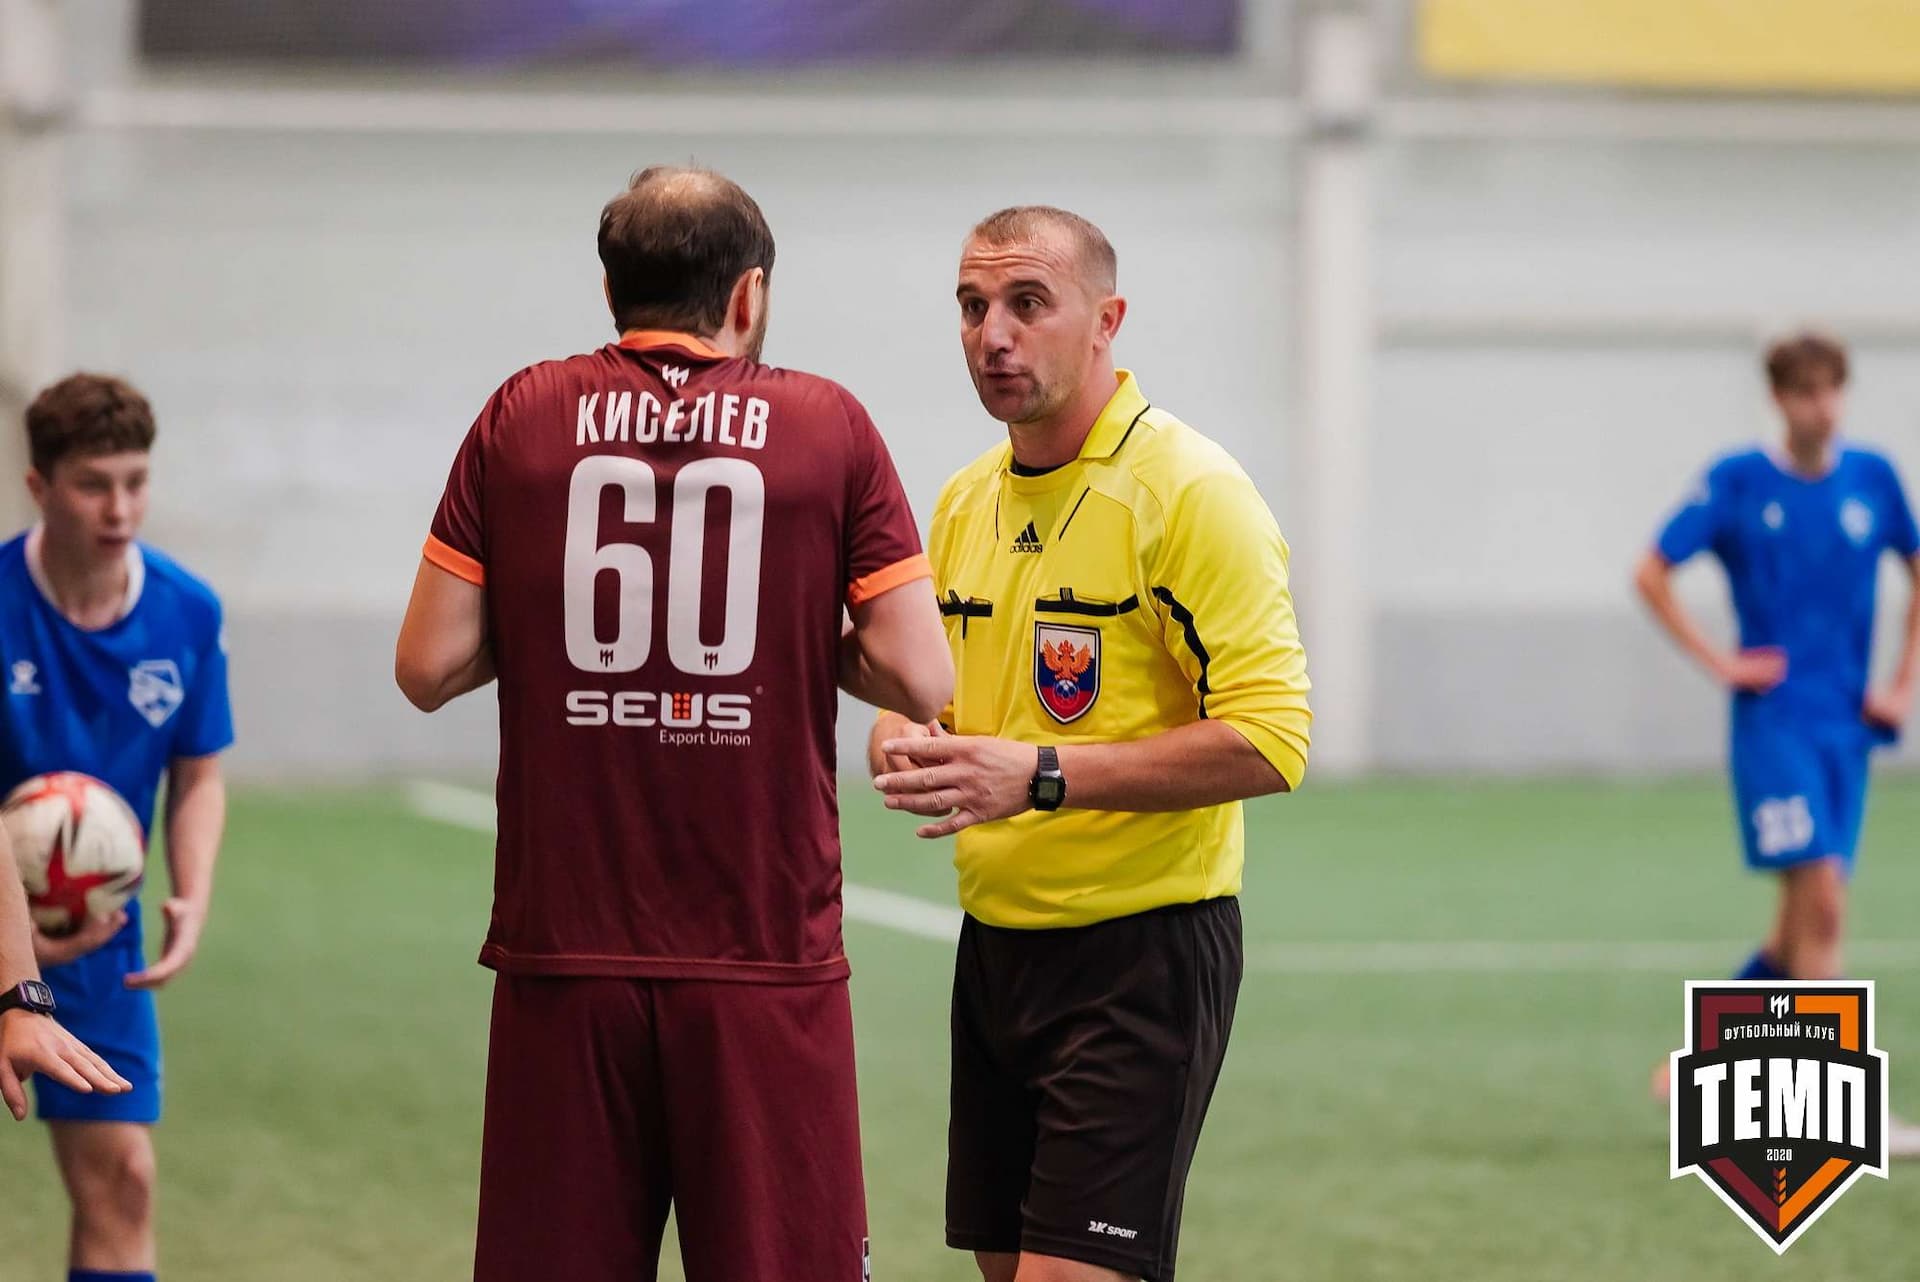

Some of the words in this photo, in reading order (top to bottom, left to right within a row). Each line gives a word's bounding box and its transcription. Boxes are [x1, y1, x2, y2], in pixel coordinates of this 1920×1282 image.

[576, 391, 770, 449] КИСЕЛЕВ
[564, 455, 765, 676] 60
[566, 690, 752, 730] SEUS
[659, 729, 705, 746] Export
[709, 732, 751, 746] Union
[1088, 1220, 1108, 1234] 2K
[1106, 1225, 1138, 1240] SPORT
